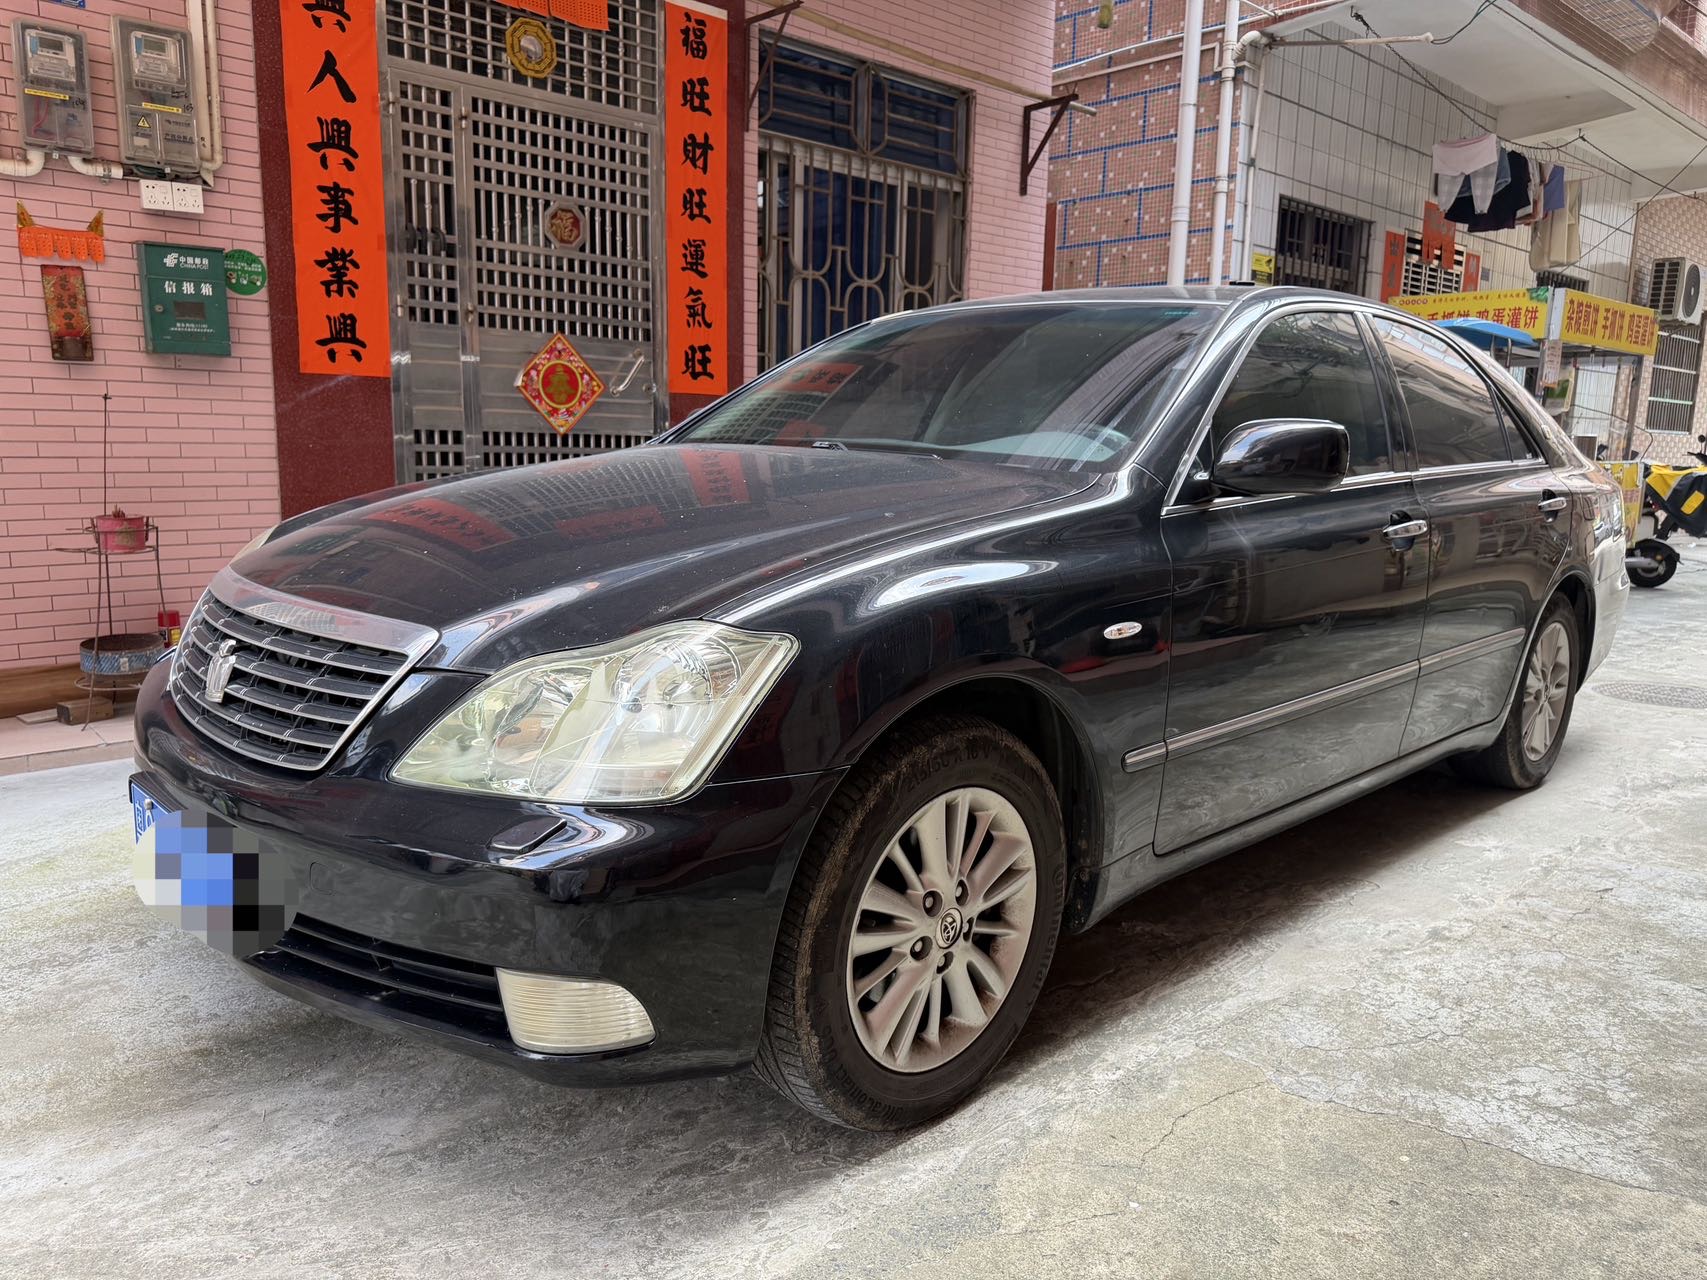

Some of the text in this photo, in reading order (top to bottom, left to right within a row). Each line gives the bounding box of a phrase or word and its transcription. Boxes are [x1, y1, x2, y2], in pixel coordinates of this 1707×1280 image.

[680, 12, 714, 380] 福旺財旺運氣旺
[179, 255, 209, 265] 中国邮政
[163, 281, 213, 296] 信报箱
[1475, 305, 1539, 329] 鸡蛋灌饼
[1565, 297, 1657, 349] 杂粮煎饼 手抓饼 鸡蛋灌饼
